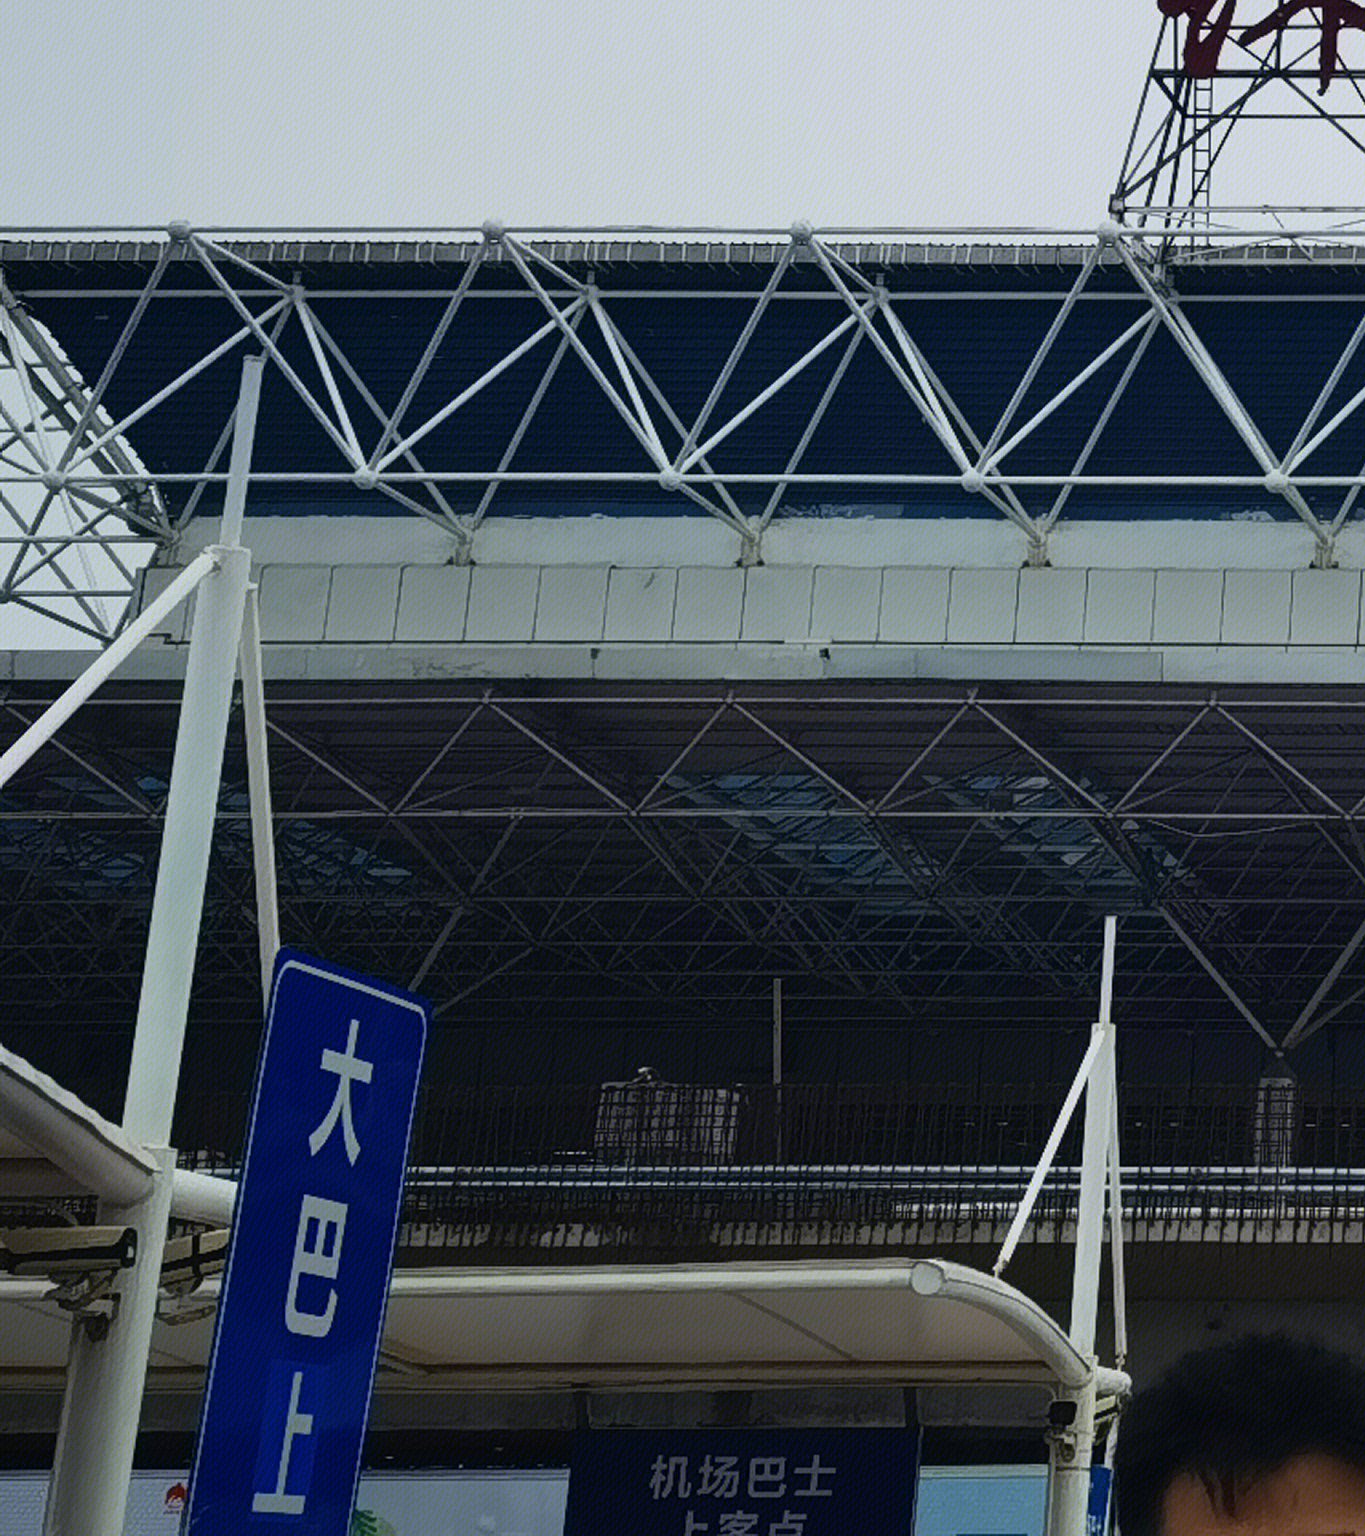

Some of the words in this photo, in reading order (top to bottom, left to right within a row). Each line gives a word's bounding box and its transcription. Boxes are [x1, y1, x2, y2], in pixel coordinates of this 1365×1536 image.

[251, 1018, 374, 1515] 大巴上
[649, 1453, 838, 1500] 机场巴士
